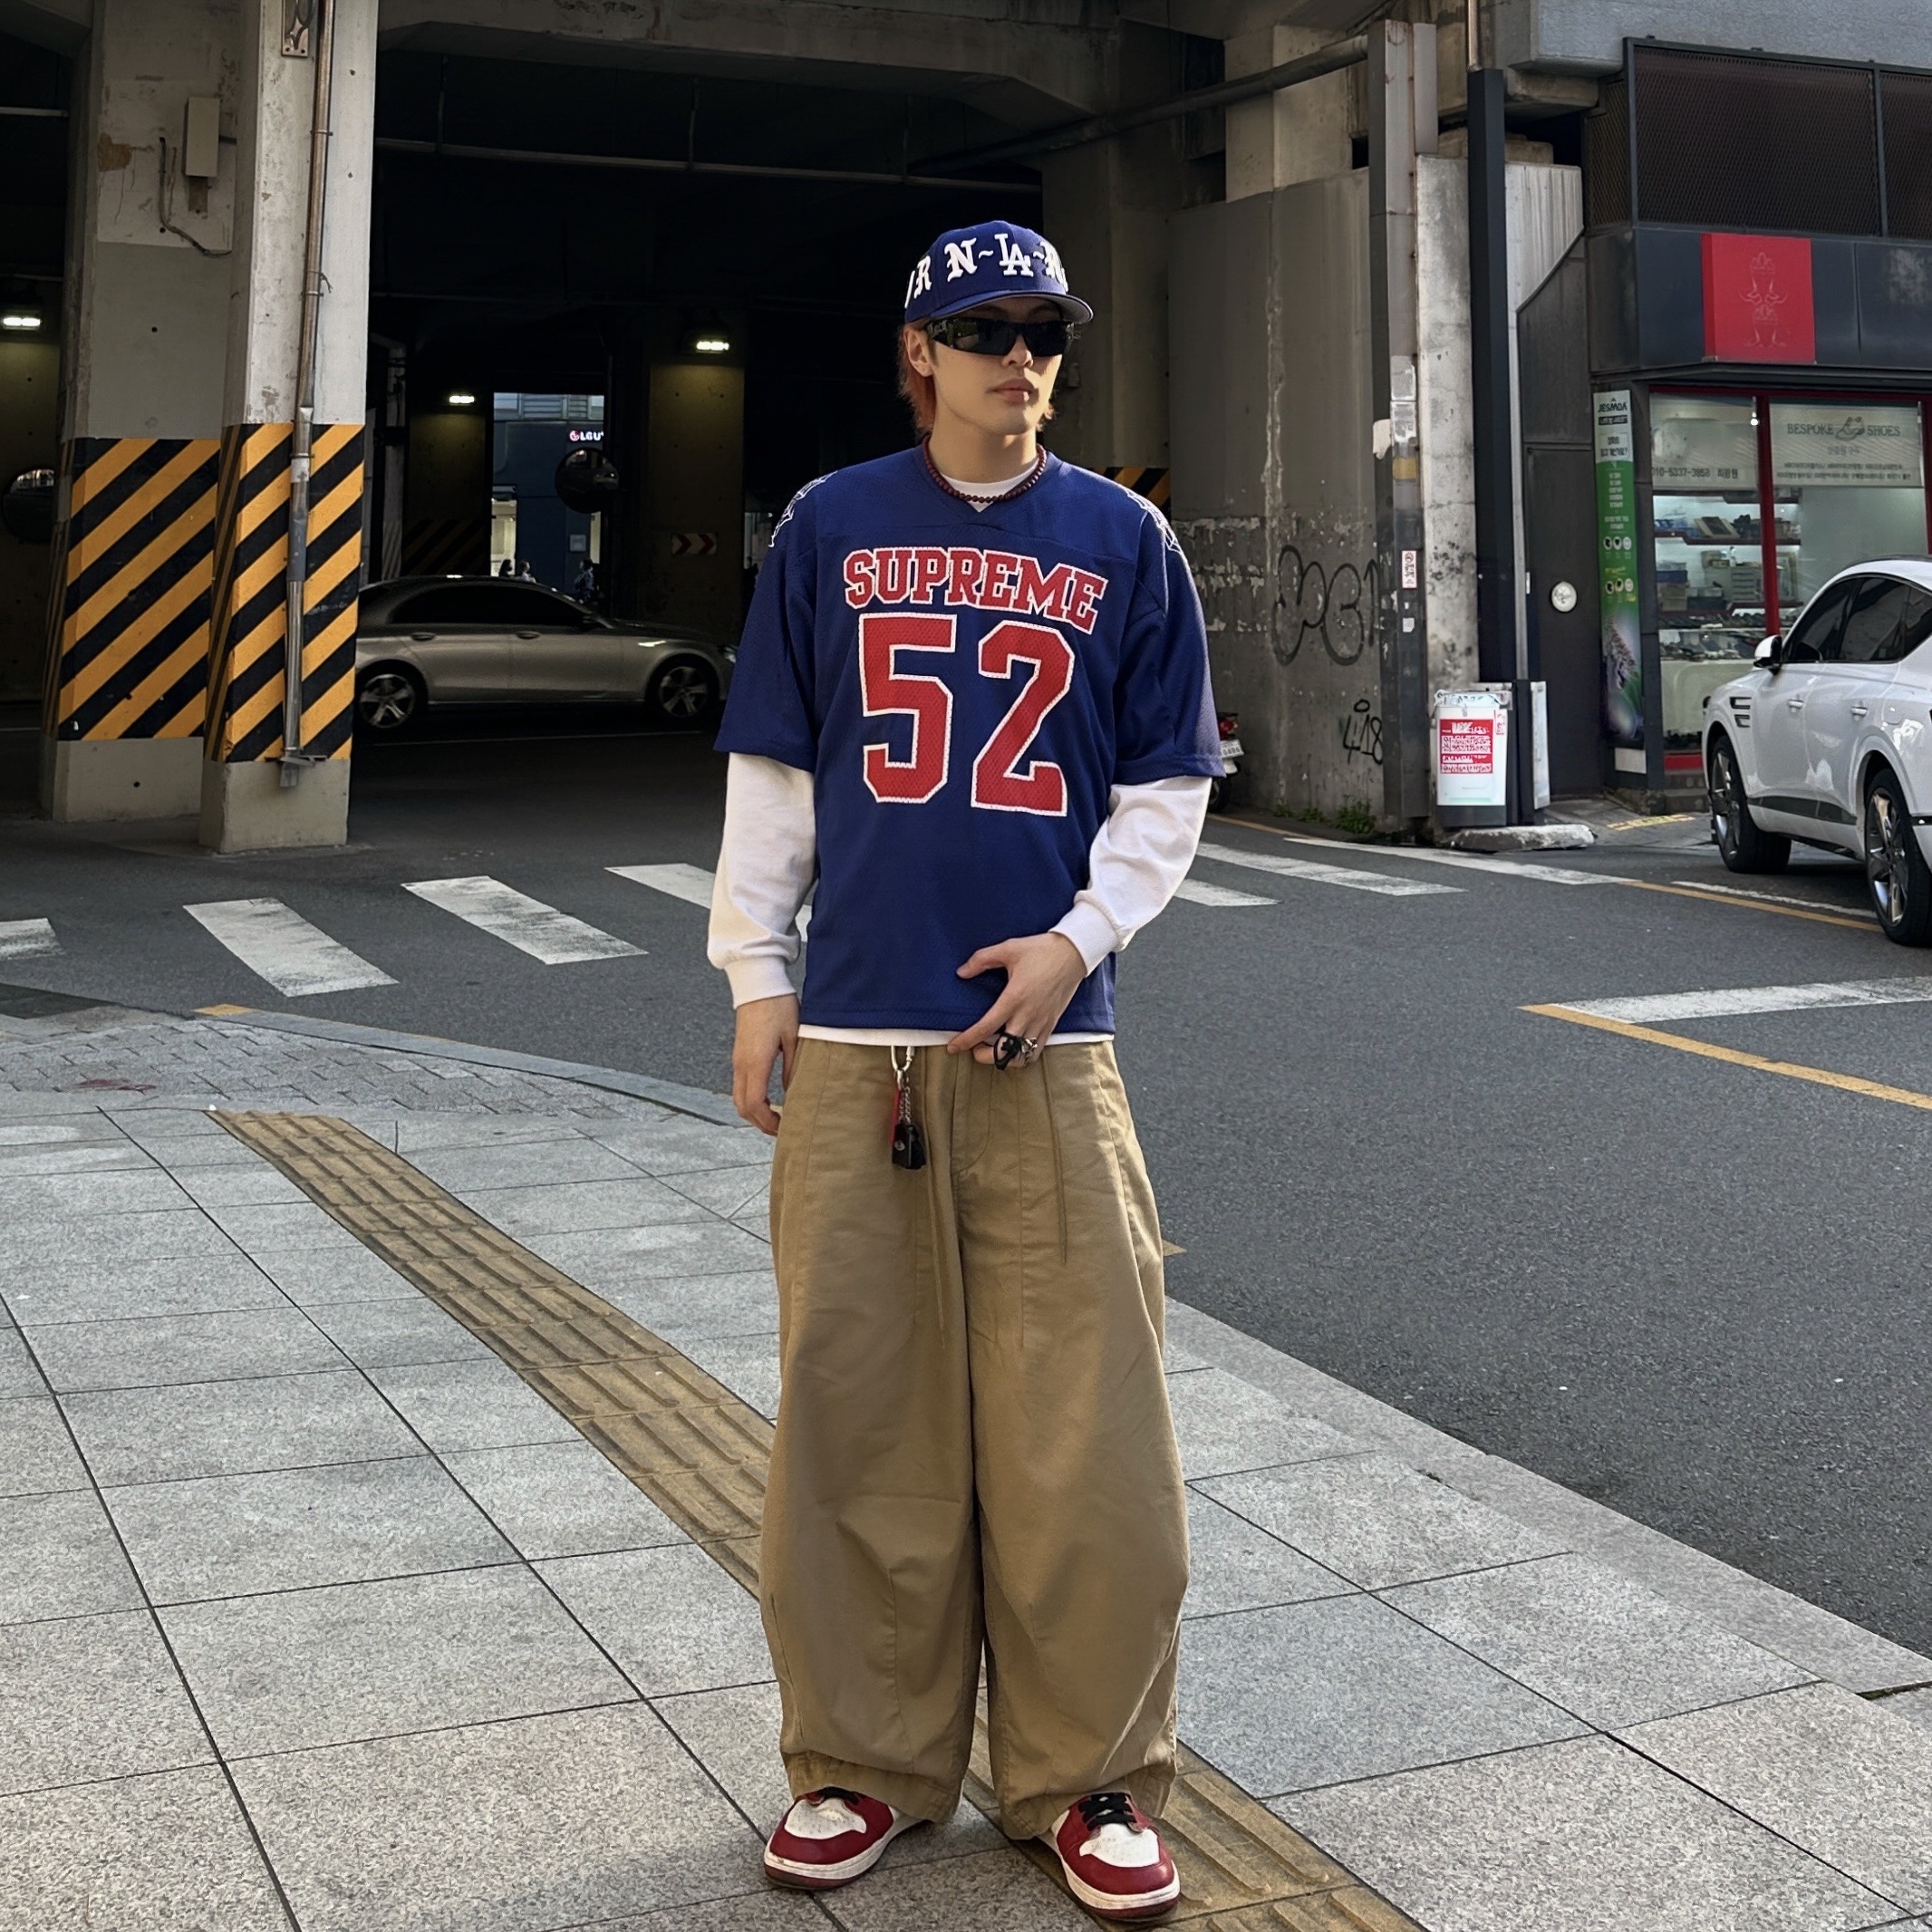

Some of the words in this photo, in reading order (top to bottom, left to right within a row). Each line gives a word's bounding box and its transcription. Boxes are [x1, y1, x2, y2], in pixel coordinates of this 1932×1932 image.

[1787, 423, 1834, 435] BESPOKE
[1868, 425, 1900, 437] SHOES
[844, 546, 1108, 634] SUPREME
[859, 613, 1075, 816] 52
